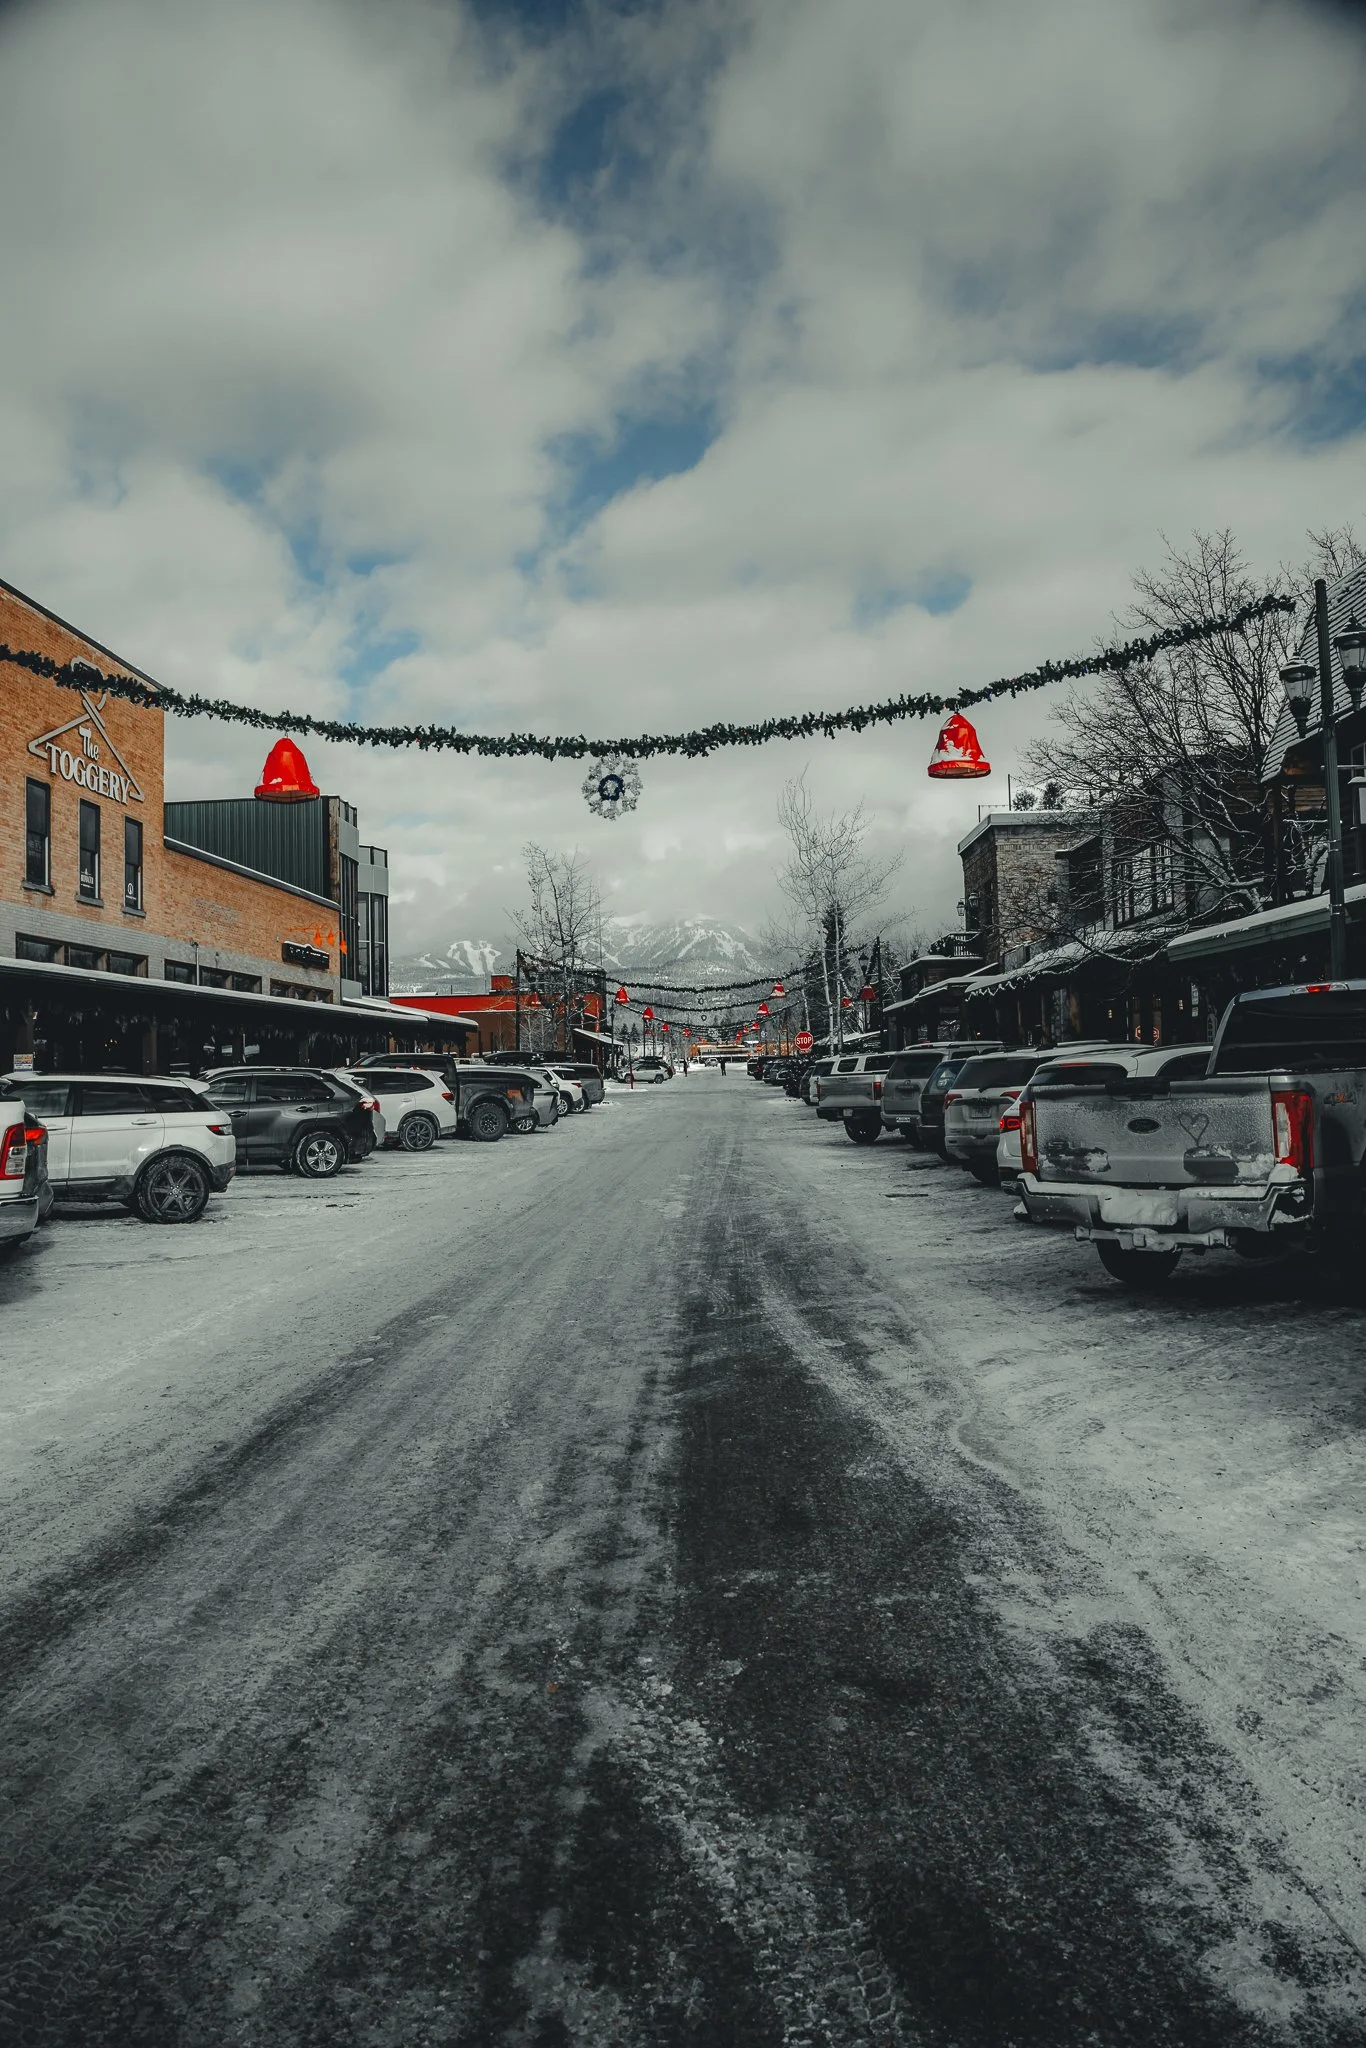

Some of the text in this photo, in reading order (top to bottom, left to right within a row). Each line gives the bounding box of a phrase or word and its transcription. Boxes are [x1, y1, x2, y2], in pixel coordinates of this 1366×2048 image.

[78, 726, 99, 760] The
[46, 742, 131, 805] TOGGERY
[796, 1036, 812, 1045] STOP
